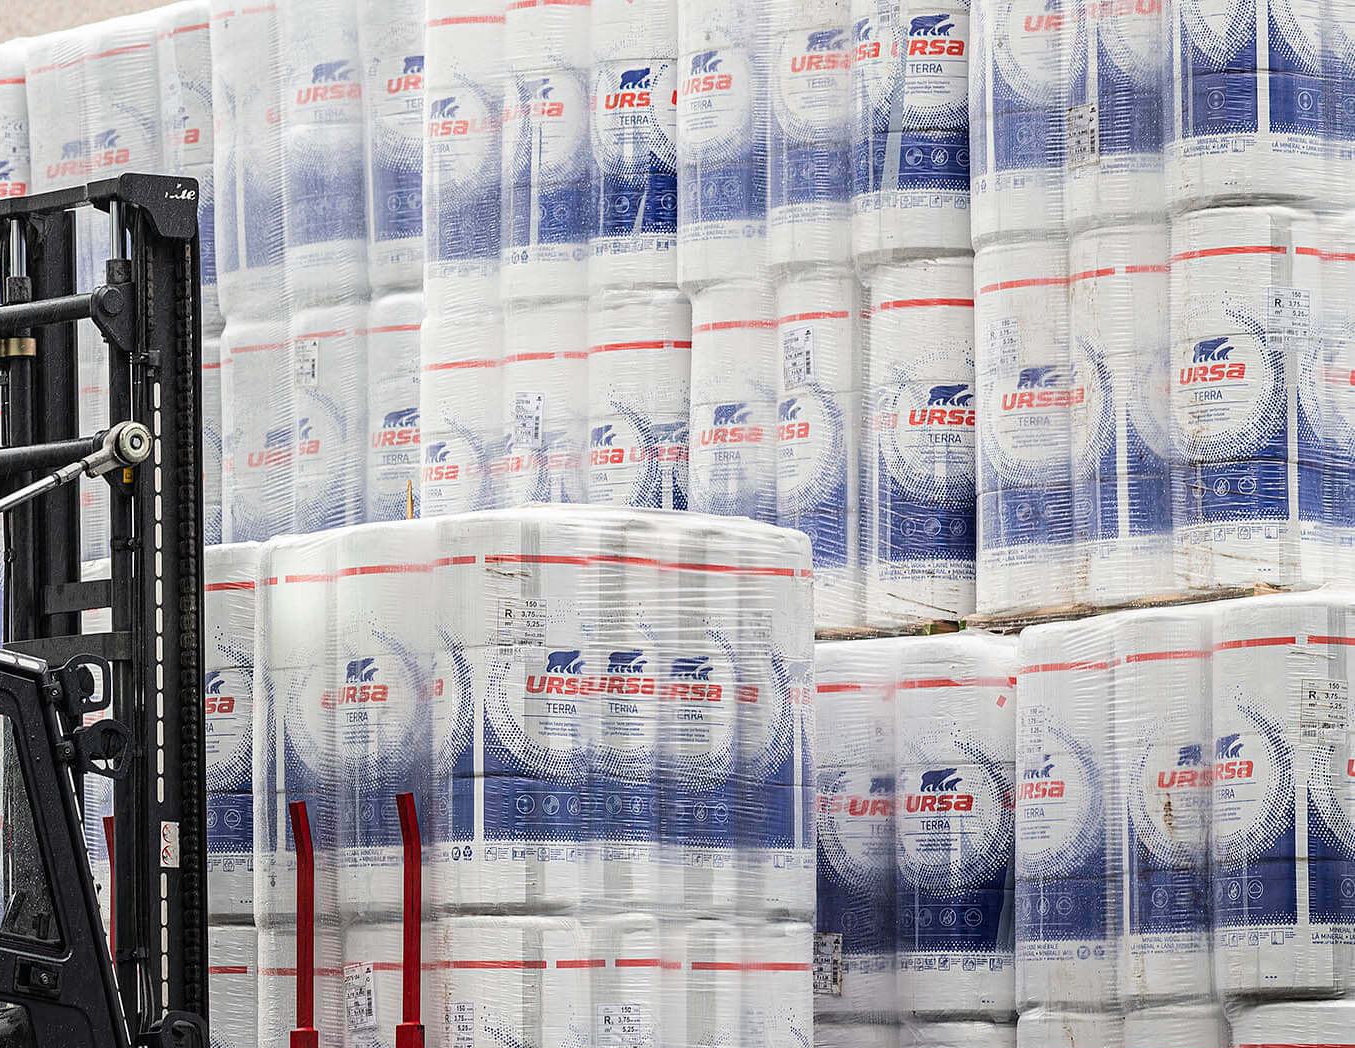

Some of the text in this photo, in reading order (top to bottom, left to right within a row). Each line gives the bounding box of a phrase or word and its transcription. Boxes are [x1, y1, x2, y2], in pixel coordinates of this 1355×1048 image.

[910, 64, 943, 74] TERRA
[387, 74, 424, 93] UR
[296, 83, 363, 105] URSA
[619, 115, 650, 126] TERRA
[427, 119, 469, 137] RSA
[1274, 298, 1282, 308] R
[1180, 362, 1246, 386] URSA
[1194, 390, 1223, 401] TERRA
[909, 409, 975, 426] URSA
[928, 434, 962, 444] TERRA
[383, 454, 410, 466] TERRA
[505, 609, 512, 618] R
[526, 675, 594, 695] URSA
[592, 676, 655, 695] URSA
[1329, 682, 1340, 690] 150
[1309, 691, 1317, 700] R
[546, 703, 577, 714] TERRA
[346, 711, 369, 723] TERRA
[677, 709, 704, 720] ERRA
[1213, 759, 1254, 780] RSA
[906, 795, 974, 813] URSA
[1023, 808, 1045, 819] TERRA
[920, 820, 951, 831] TERRA
[621, 1006, 632, 1014] 150
[604, 1015, 612, 1024] R
